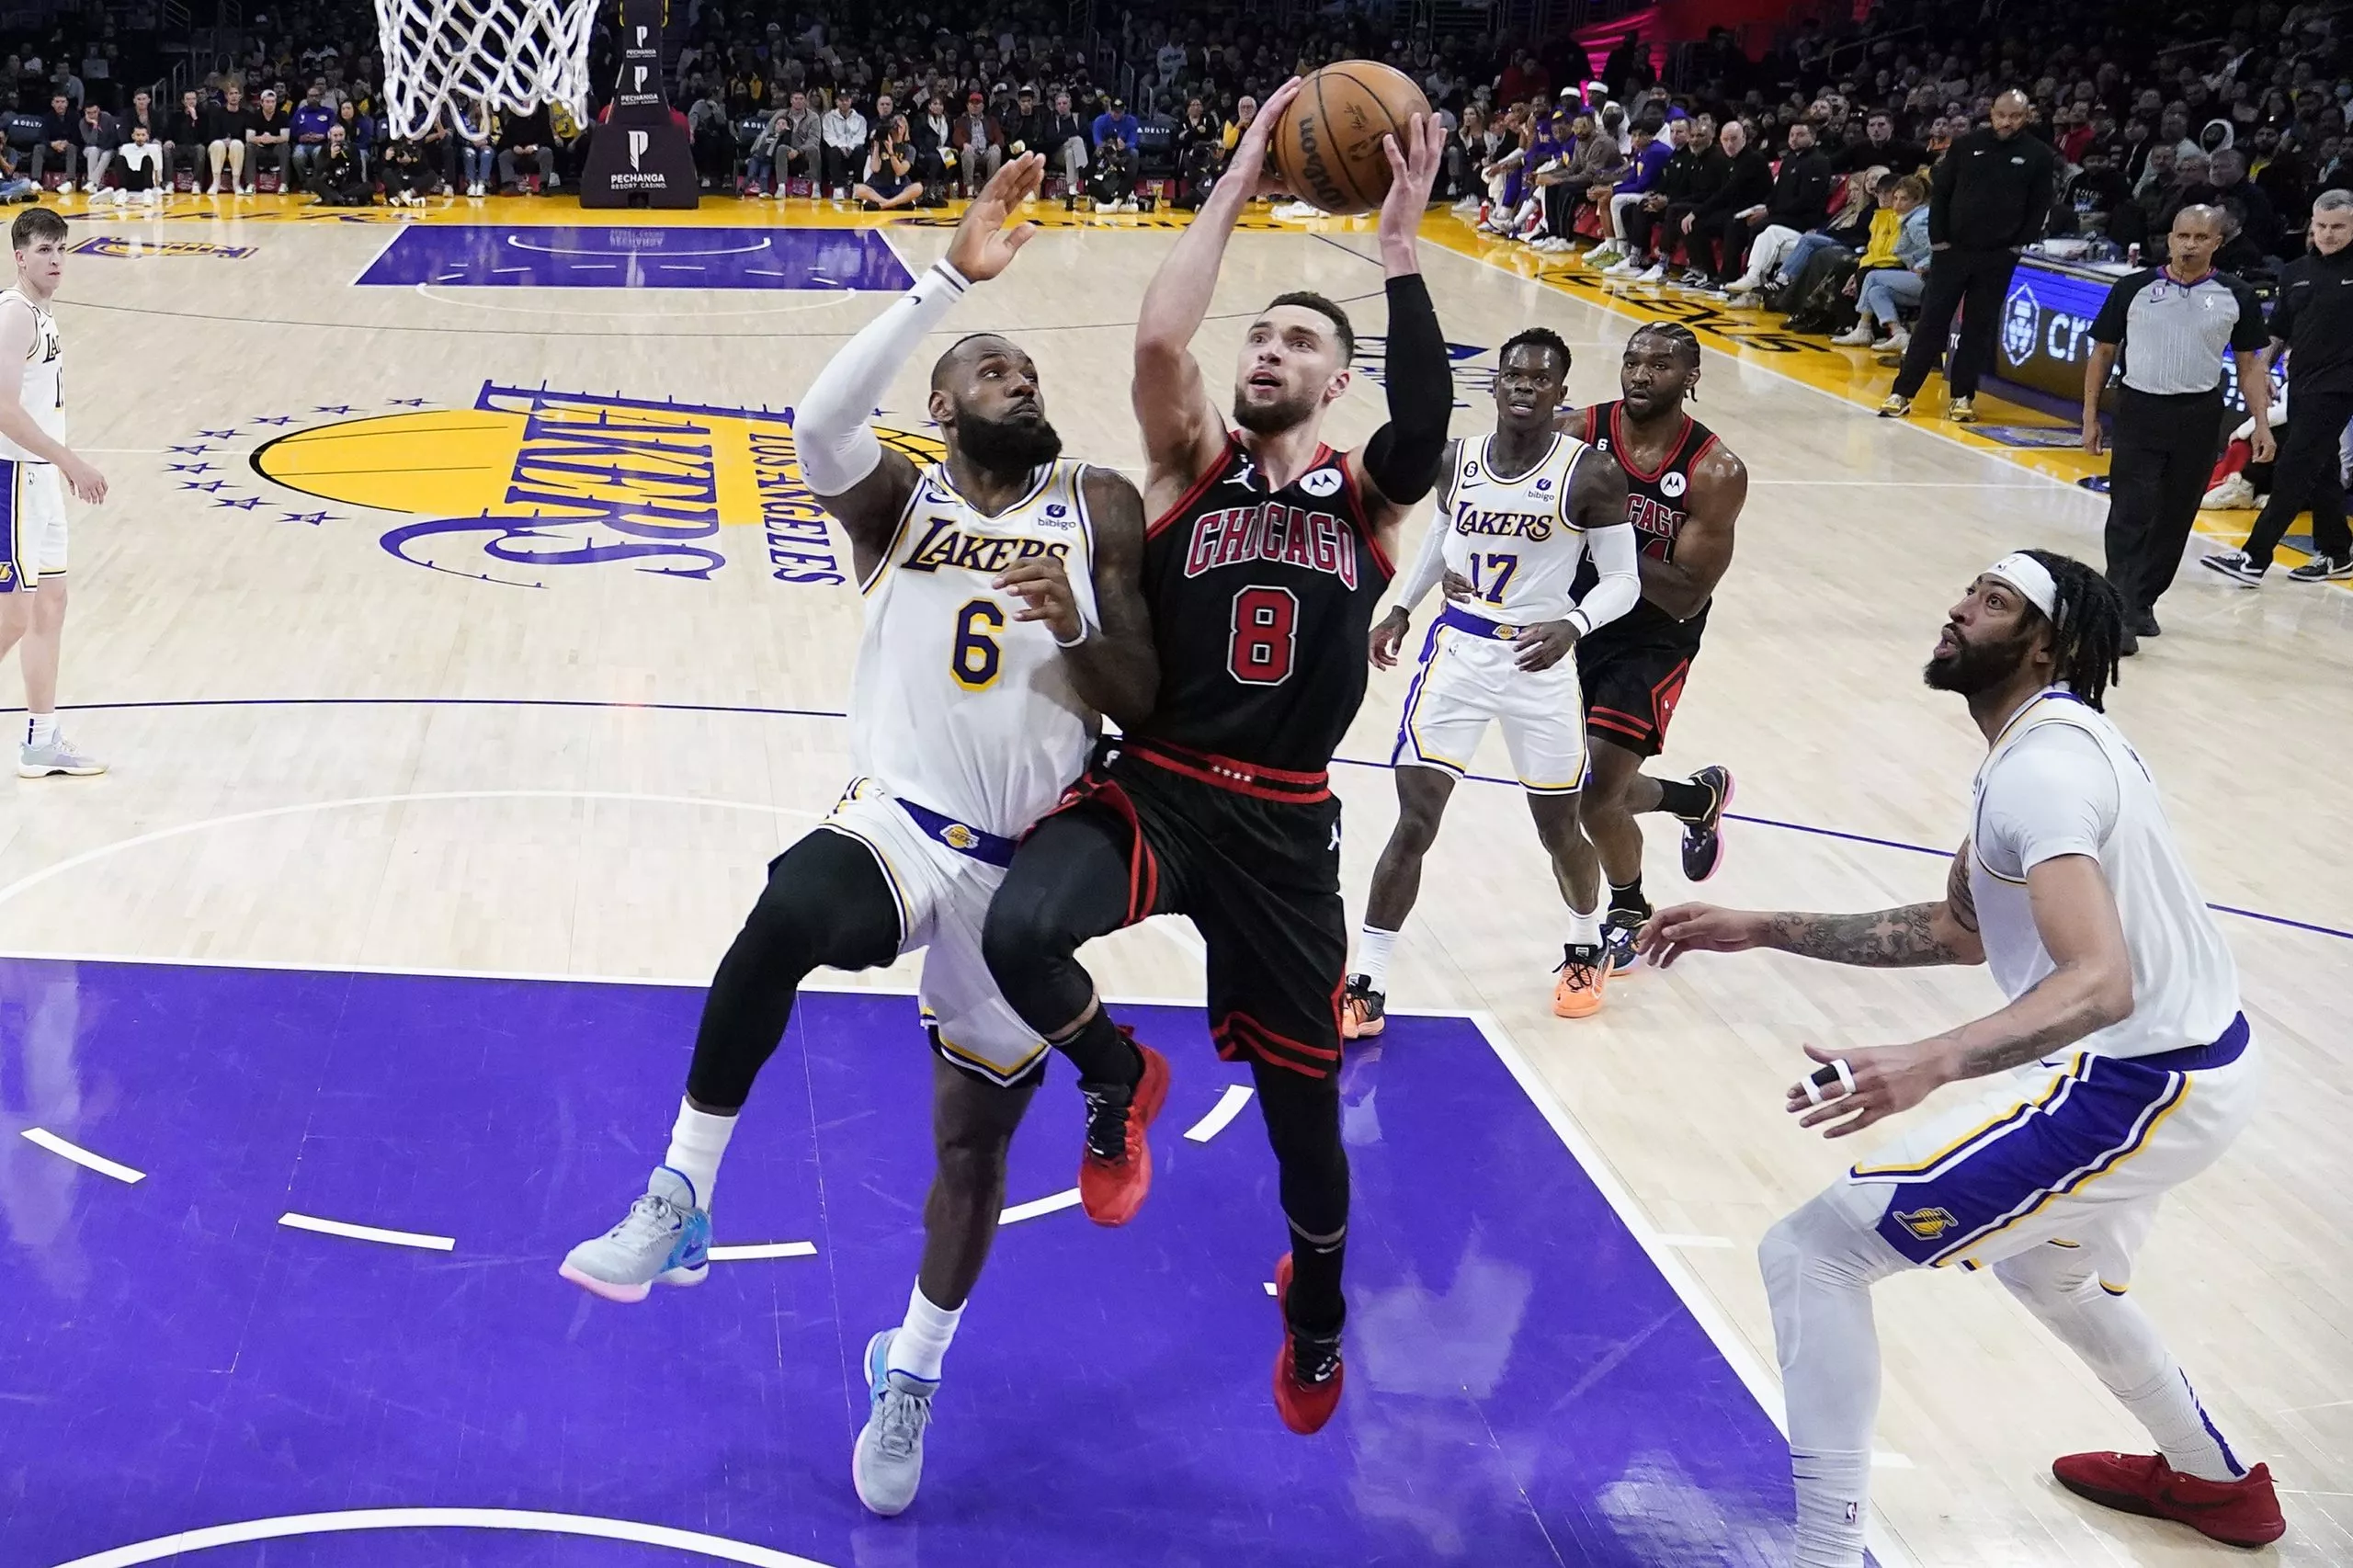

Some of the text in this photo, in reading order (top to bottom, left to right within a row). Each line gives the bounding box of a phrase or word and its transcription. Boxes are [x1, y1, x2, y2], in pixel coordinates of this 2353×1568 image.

[610, 173, 665, 184] PECHANGA
[1597, 438, 1608, 450] 6
[1464, 462, 1478, 477] 6
[748, 430, 847, 586] LOS ANGELES
[1528, 489, 1555, 502] bibigo
[1037, 517, 1076, 531] bibigo
[1455, 501, 1553, 541] LAKERS
[1184, 501, 1358, 592] CHICAGO
[1470, 552, 1518, 608] 17
[949, 597, 1006, 692] 6
[1226, 585, 1299, 687] 8
